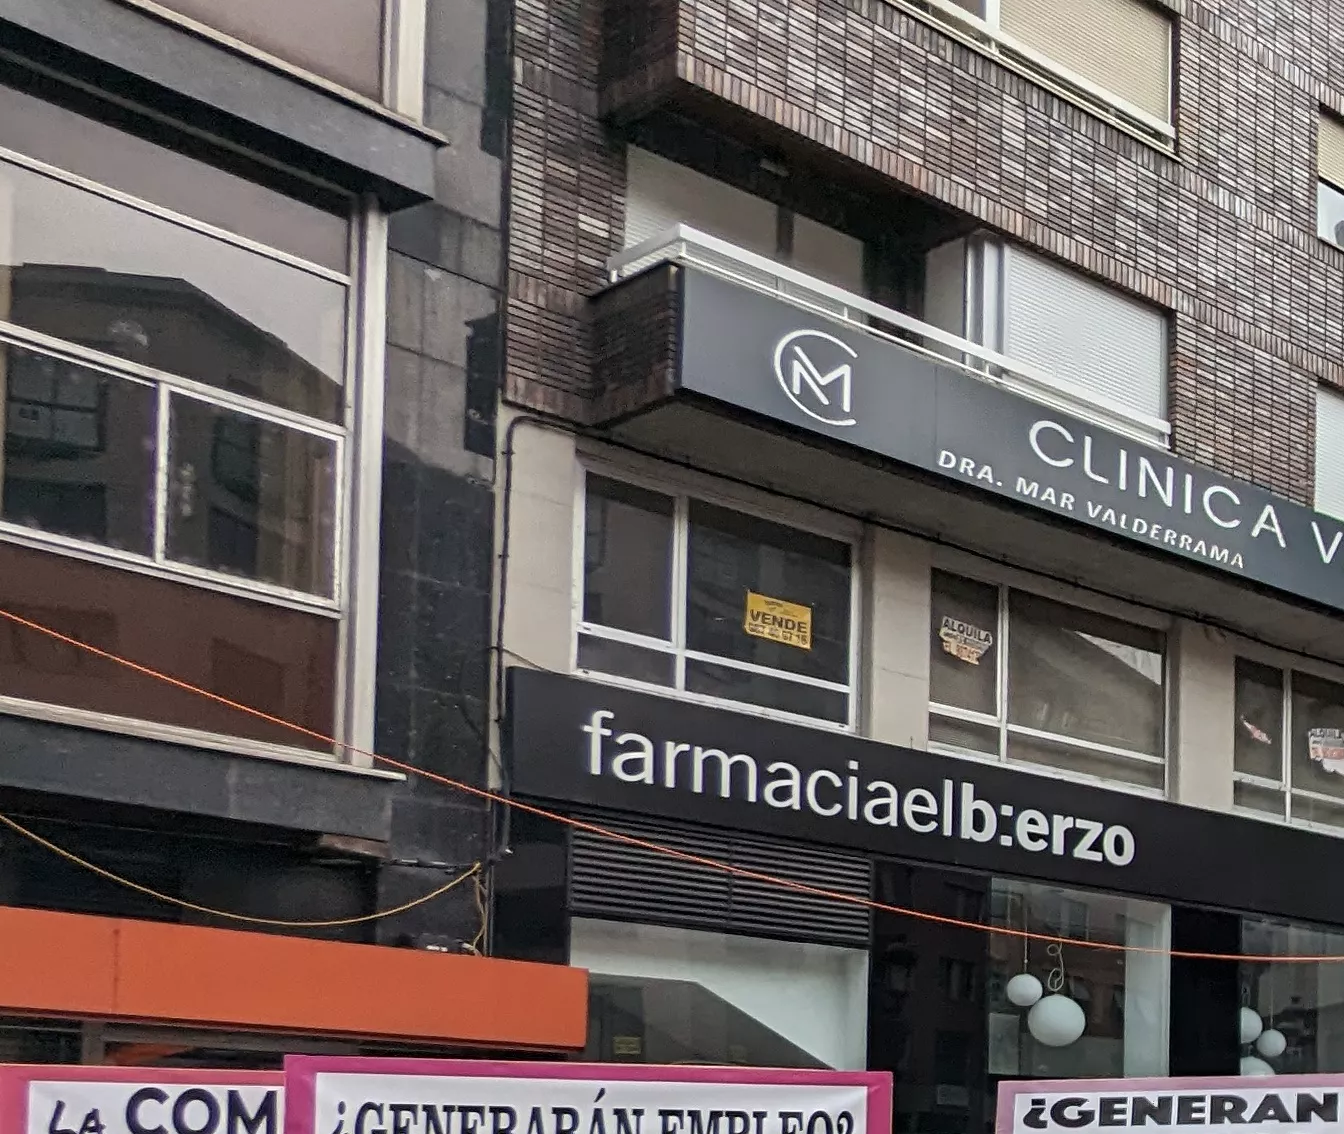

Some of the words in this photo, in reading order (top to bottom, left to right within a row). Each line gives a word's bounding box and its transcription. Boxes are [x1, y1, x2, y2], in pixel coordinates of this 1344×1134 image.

[1029, 420, 1288, 548] CLINICA
[938, 449, 1003, 488] DRA.
[1015, 476, 1076, 511] MAR
[1086, 500, 1245, 570] VALDERRAMA
[749, 609, 808, 634] VENDE
[943, 617, 992, 644] ALQUILA
[1022, 1092, 1339, 1129] ¿GENERAN
